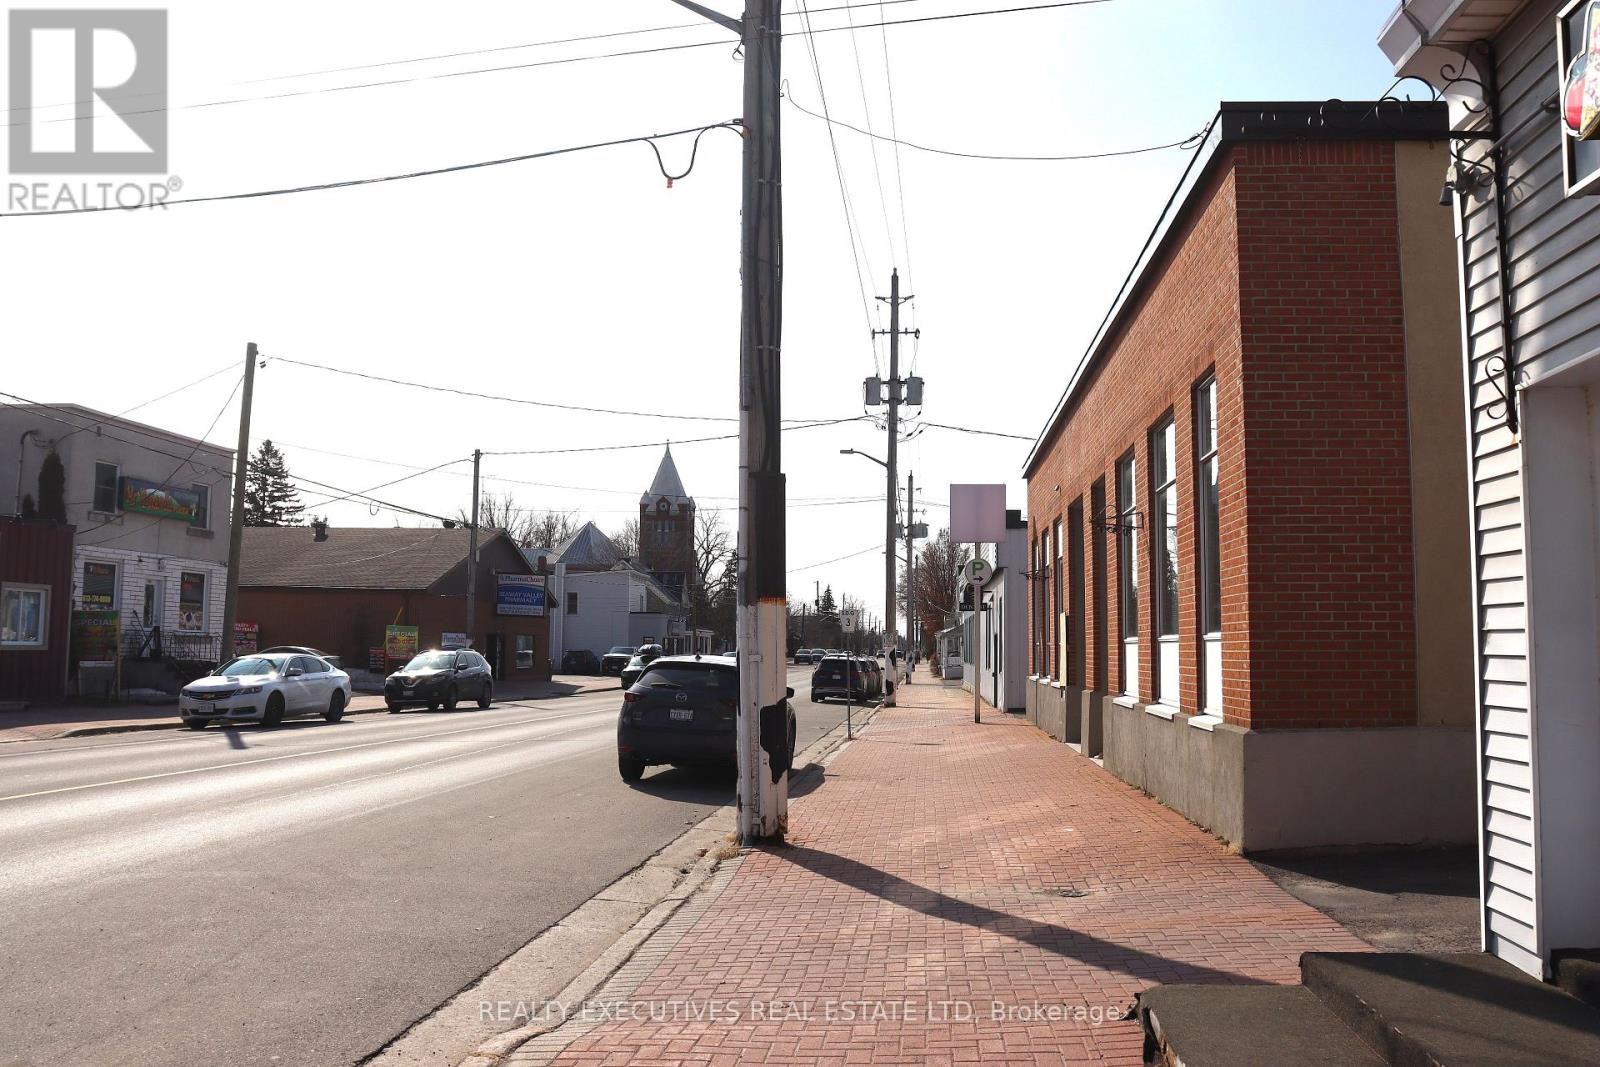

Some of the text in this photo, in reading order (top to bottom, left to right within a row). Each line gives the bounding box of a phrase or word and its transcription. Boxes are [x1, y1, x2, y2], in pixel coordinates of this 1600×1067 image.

[972, 561, 984, 576] P
[522, 592, 544, 600] VALLEY
[846, 617, 851, 626] 3
